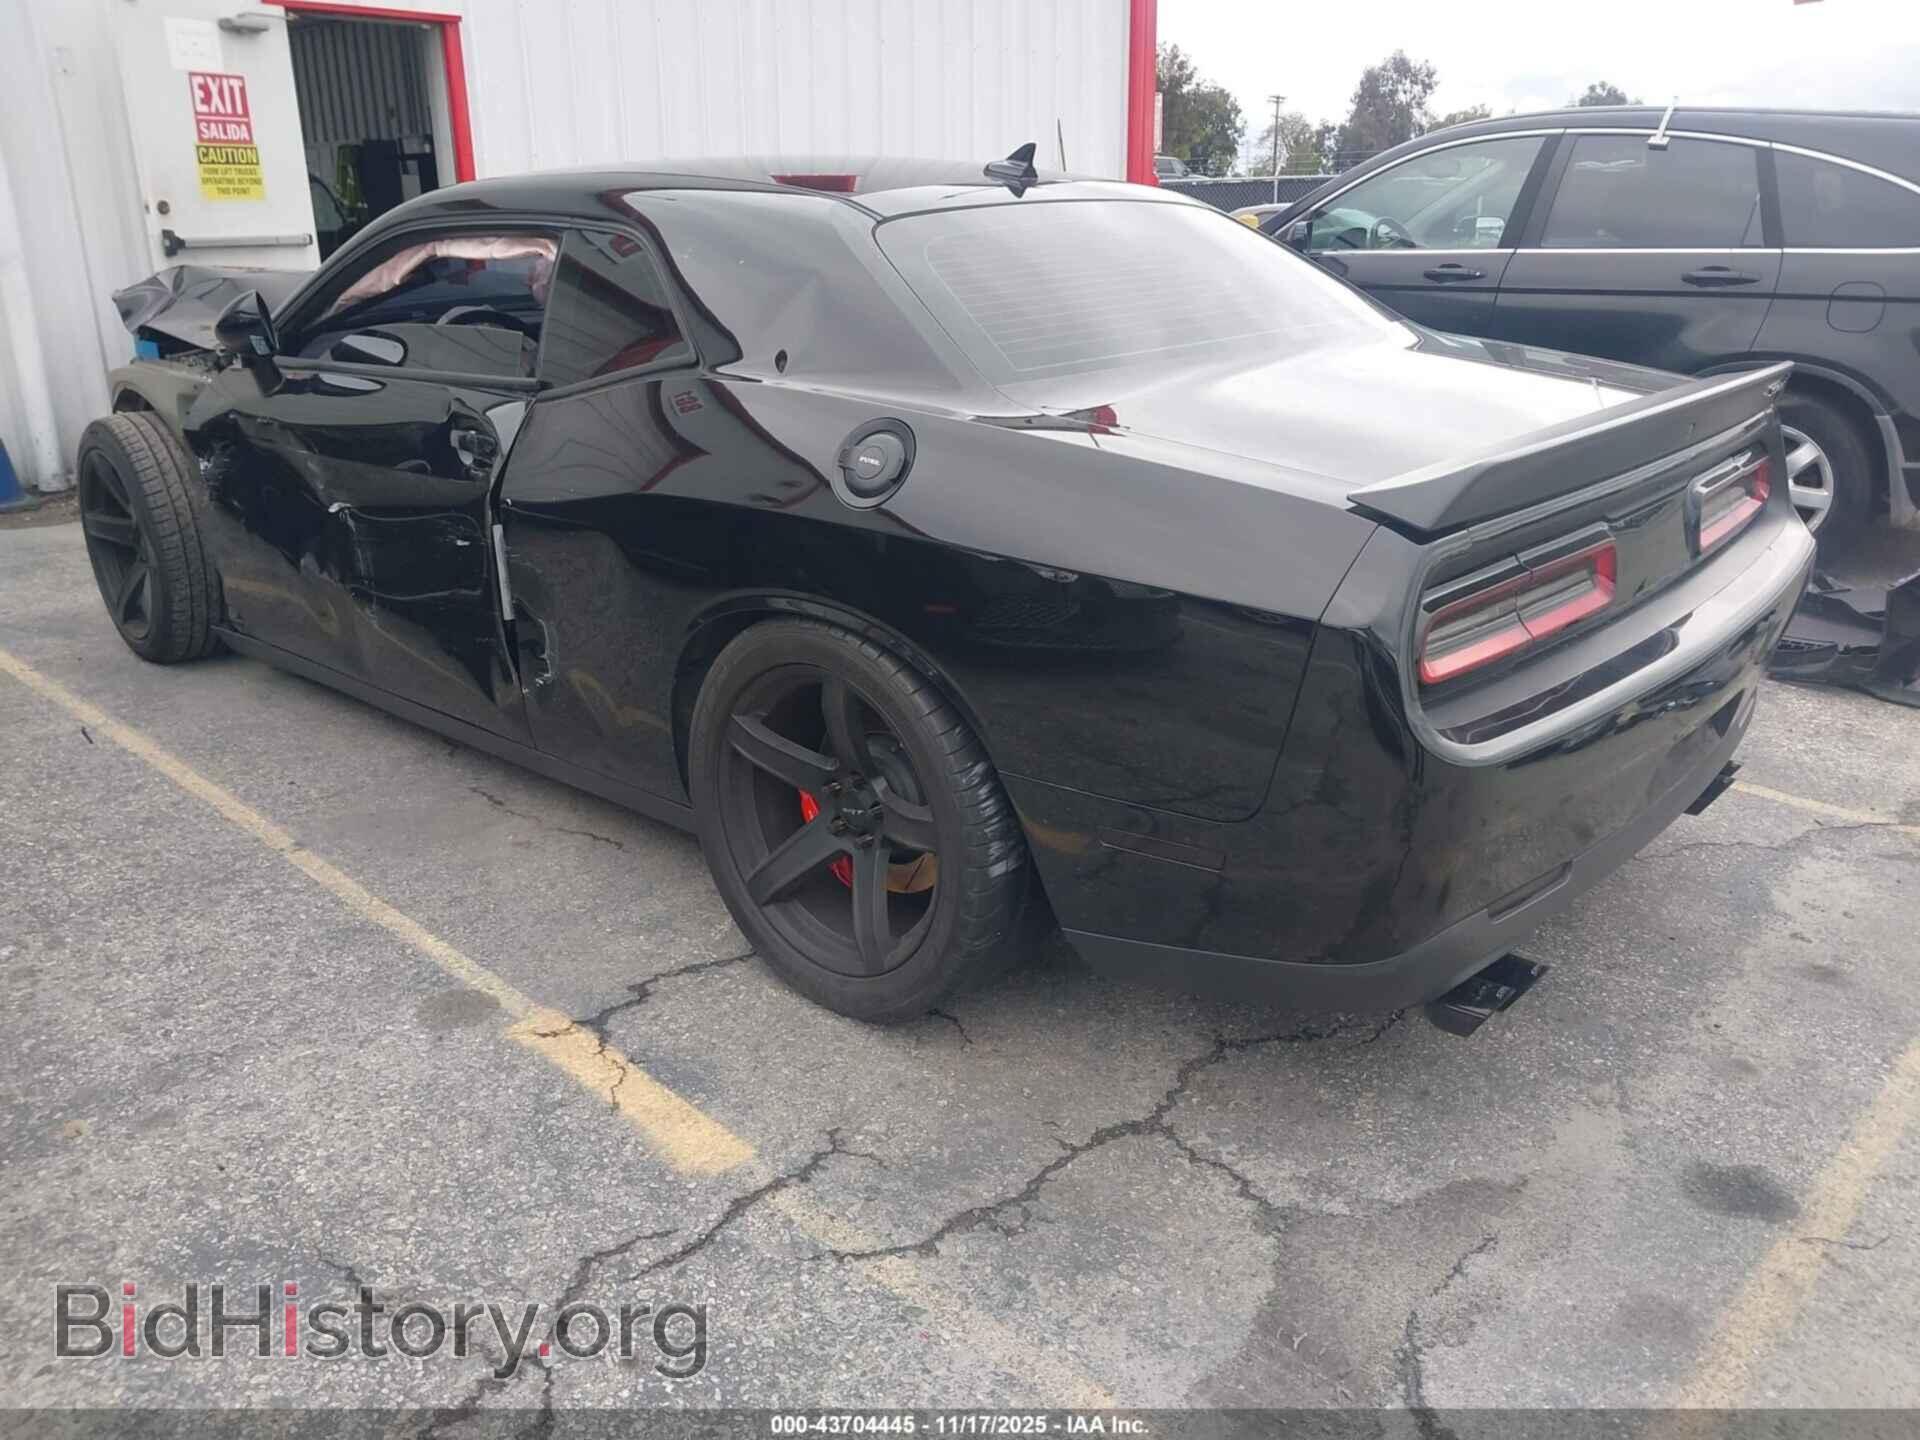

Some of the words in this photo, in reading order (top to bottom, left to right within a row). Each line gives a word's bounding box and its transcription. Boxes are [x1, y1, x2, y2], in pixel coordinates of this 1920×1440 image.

[191, 76, 243, 114] EXIT
[200, 121, 250, 141] SALIDA
[199, 146, 257, 164] CAUTION
